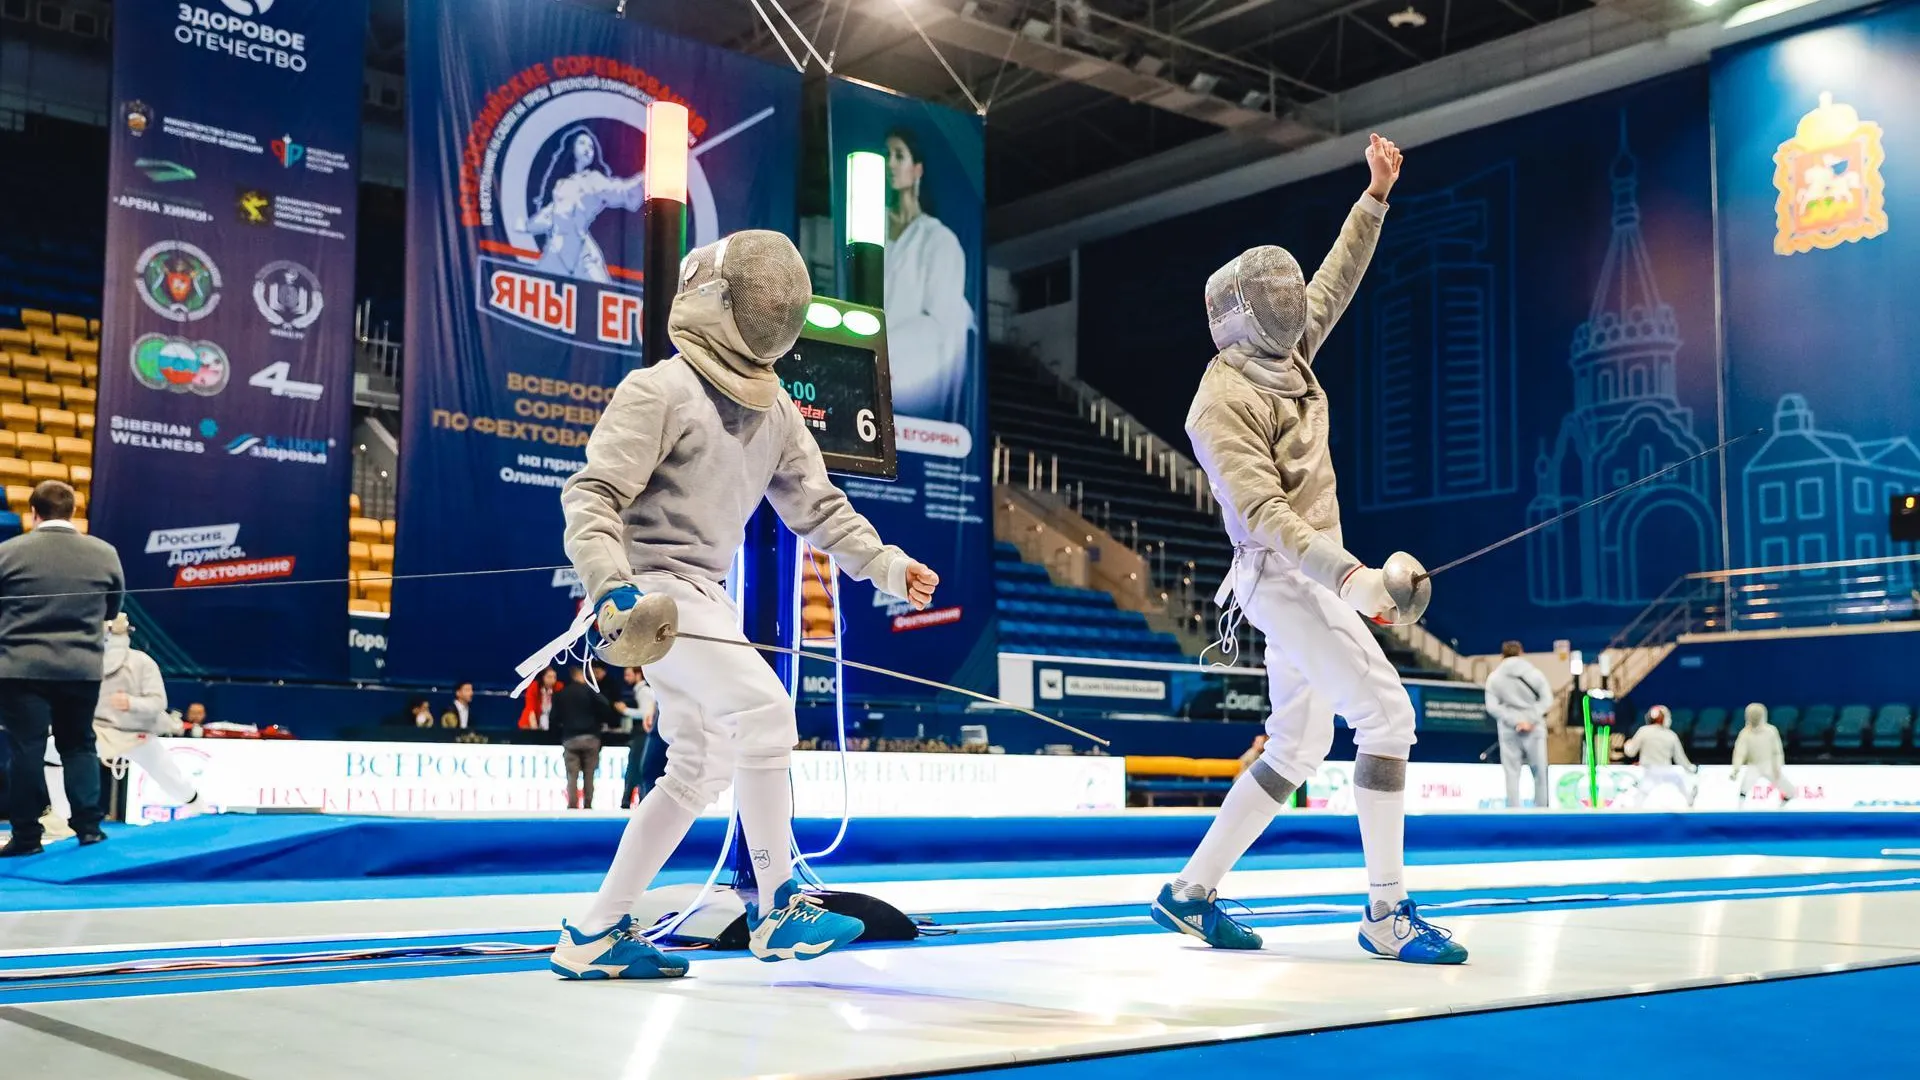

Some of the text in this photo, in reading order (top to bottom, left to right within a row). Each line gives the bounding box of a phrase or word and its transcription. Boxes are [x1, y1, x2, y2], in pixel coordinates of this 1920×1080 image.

[178, 3, 305, 51] ЗДОРОВОЕ
[174, 25, 307, 72] ОТЕЧЕСТВО
[491, 272, 643, 343] ЯНЫ ЕГ
[779, 377, 816, 401] :00
[110, 415, 192, 437] SIBERIAN
[431, 409, 469, 432] ПО
[857, 408, 877, 442] 6
[110, 429, 205, 454] WELLNESS
[517, 453, 541, 468] на
[180, 558, 291, 582] Фехтование
